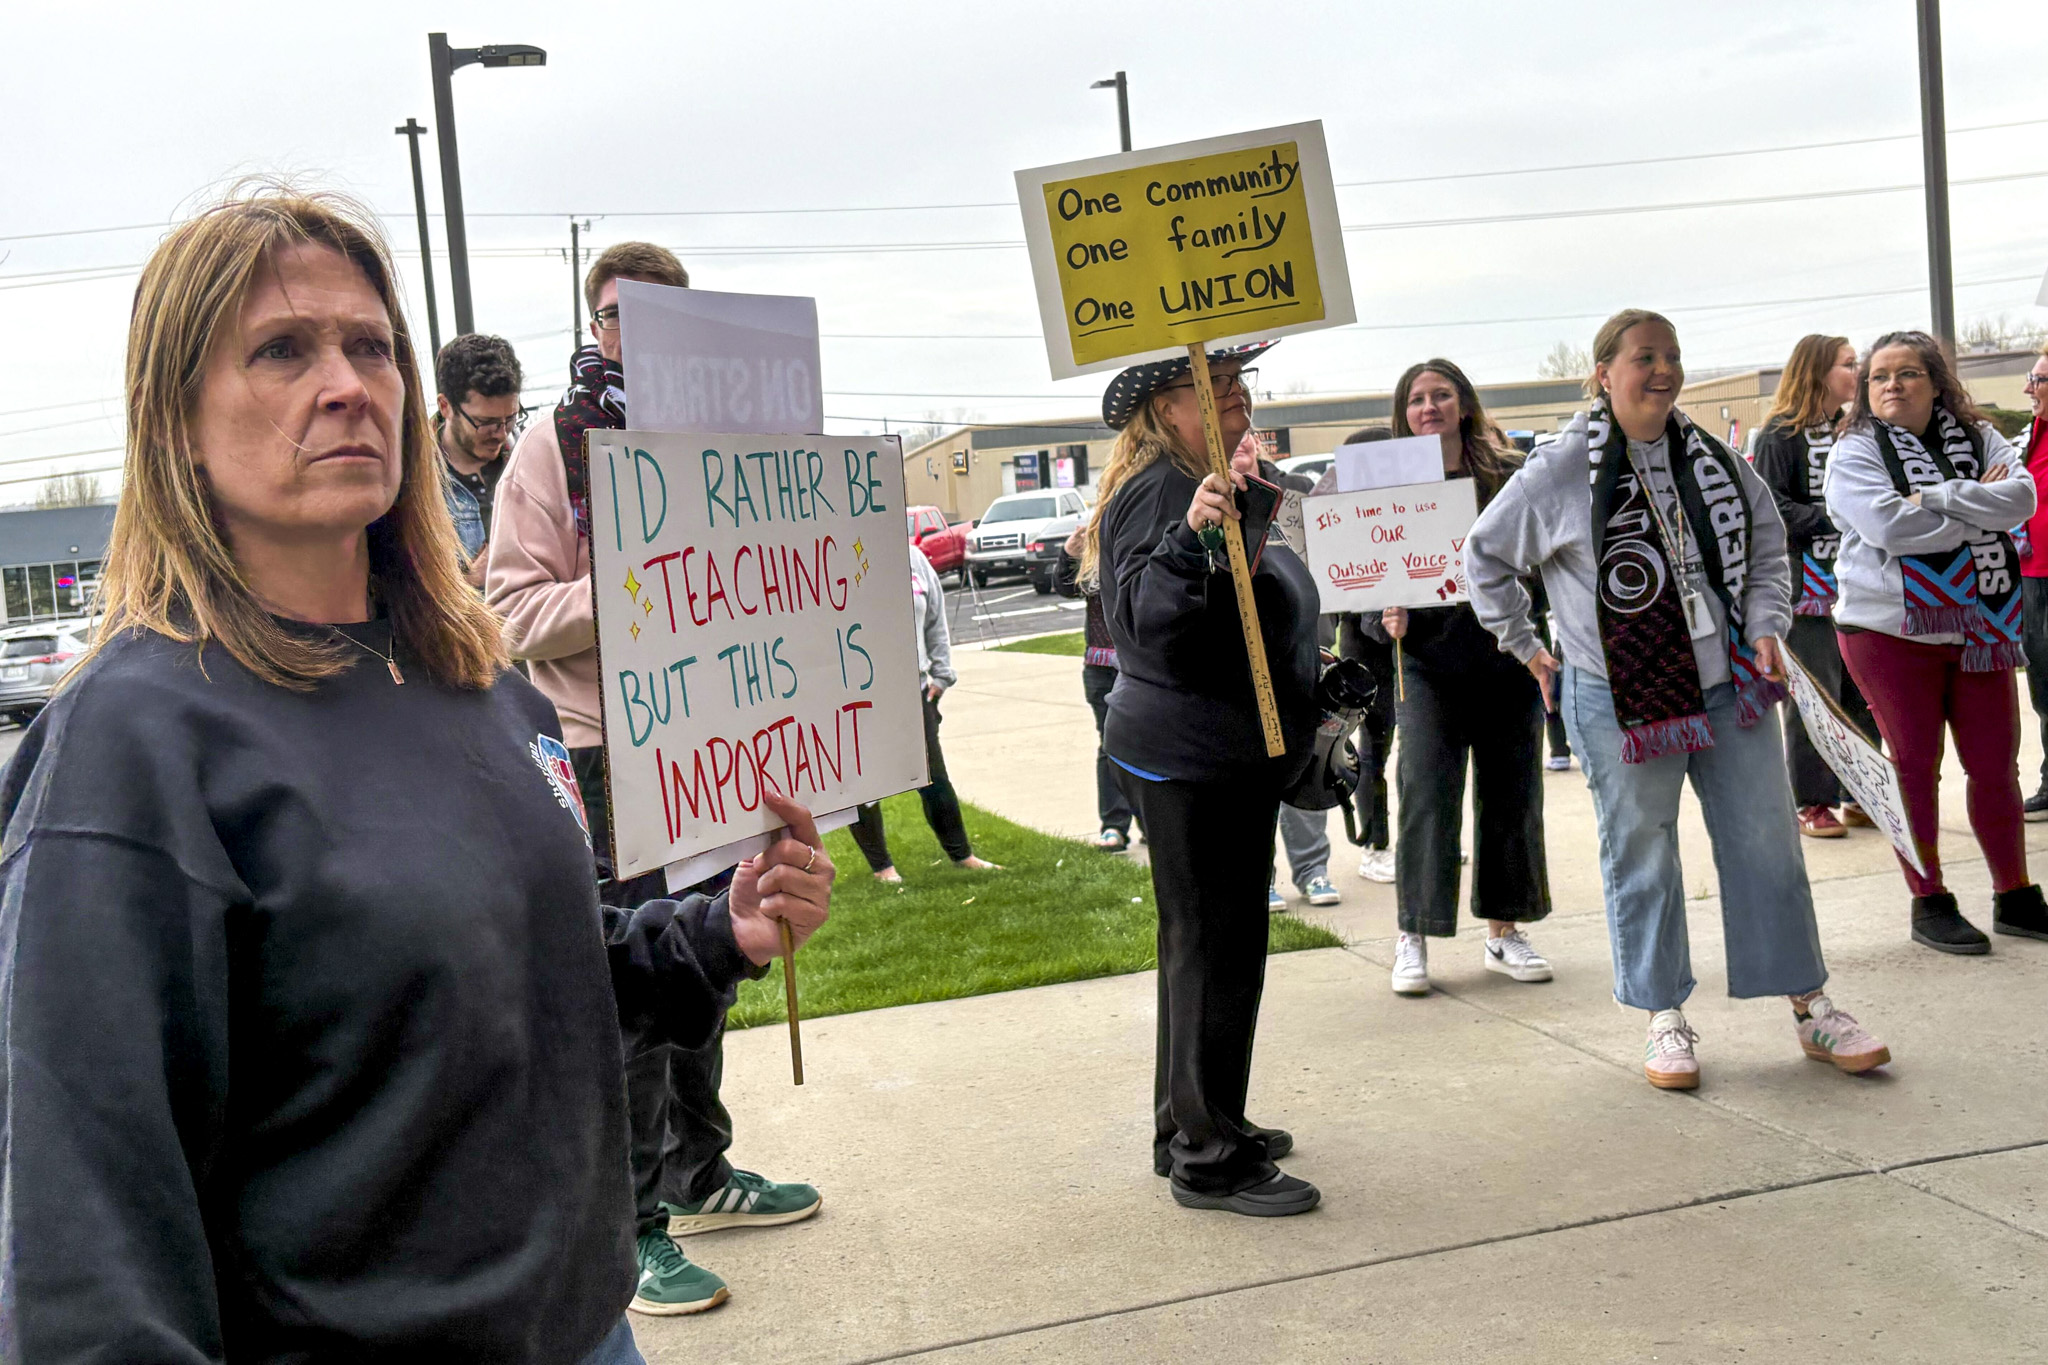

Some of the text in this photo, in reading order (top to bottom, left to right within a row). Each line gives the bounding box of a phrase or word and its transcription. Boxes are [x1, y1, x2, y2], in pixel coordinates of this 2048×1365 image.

[1058, 150, 1299, 221] One Community
[1168, 206, 1286, 258] family
[1074, 261, 1296, 327] One UNION
[608, 446, 886, 551] I'D RATHER BE
[1316, 501, 1437, 531] It's time to use
[1371, 525, 1407, 544] OUR
[643, 535, 848, 634] TEACHING
[1328, 558, 1388, 580] Outside
[619, 623, 874, 747] BUT THIS IS
[656, 701, 873, 844] IMPORTANT
